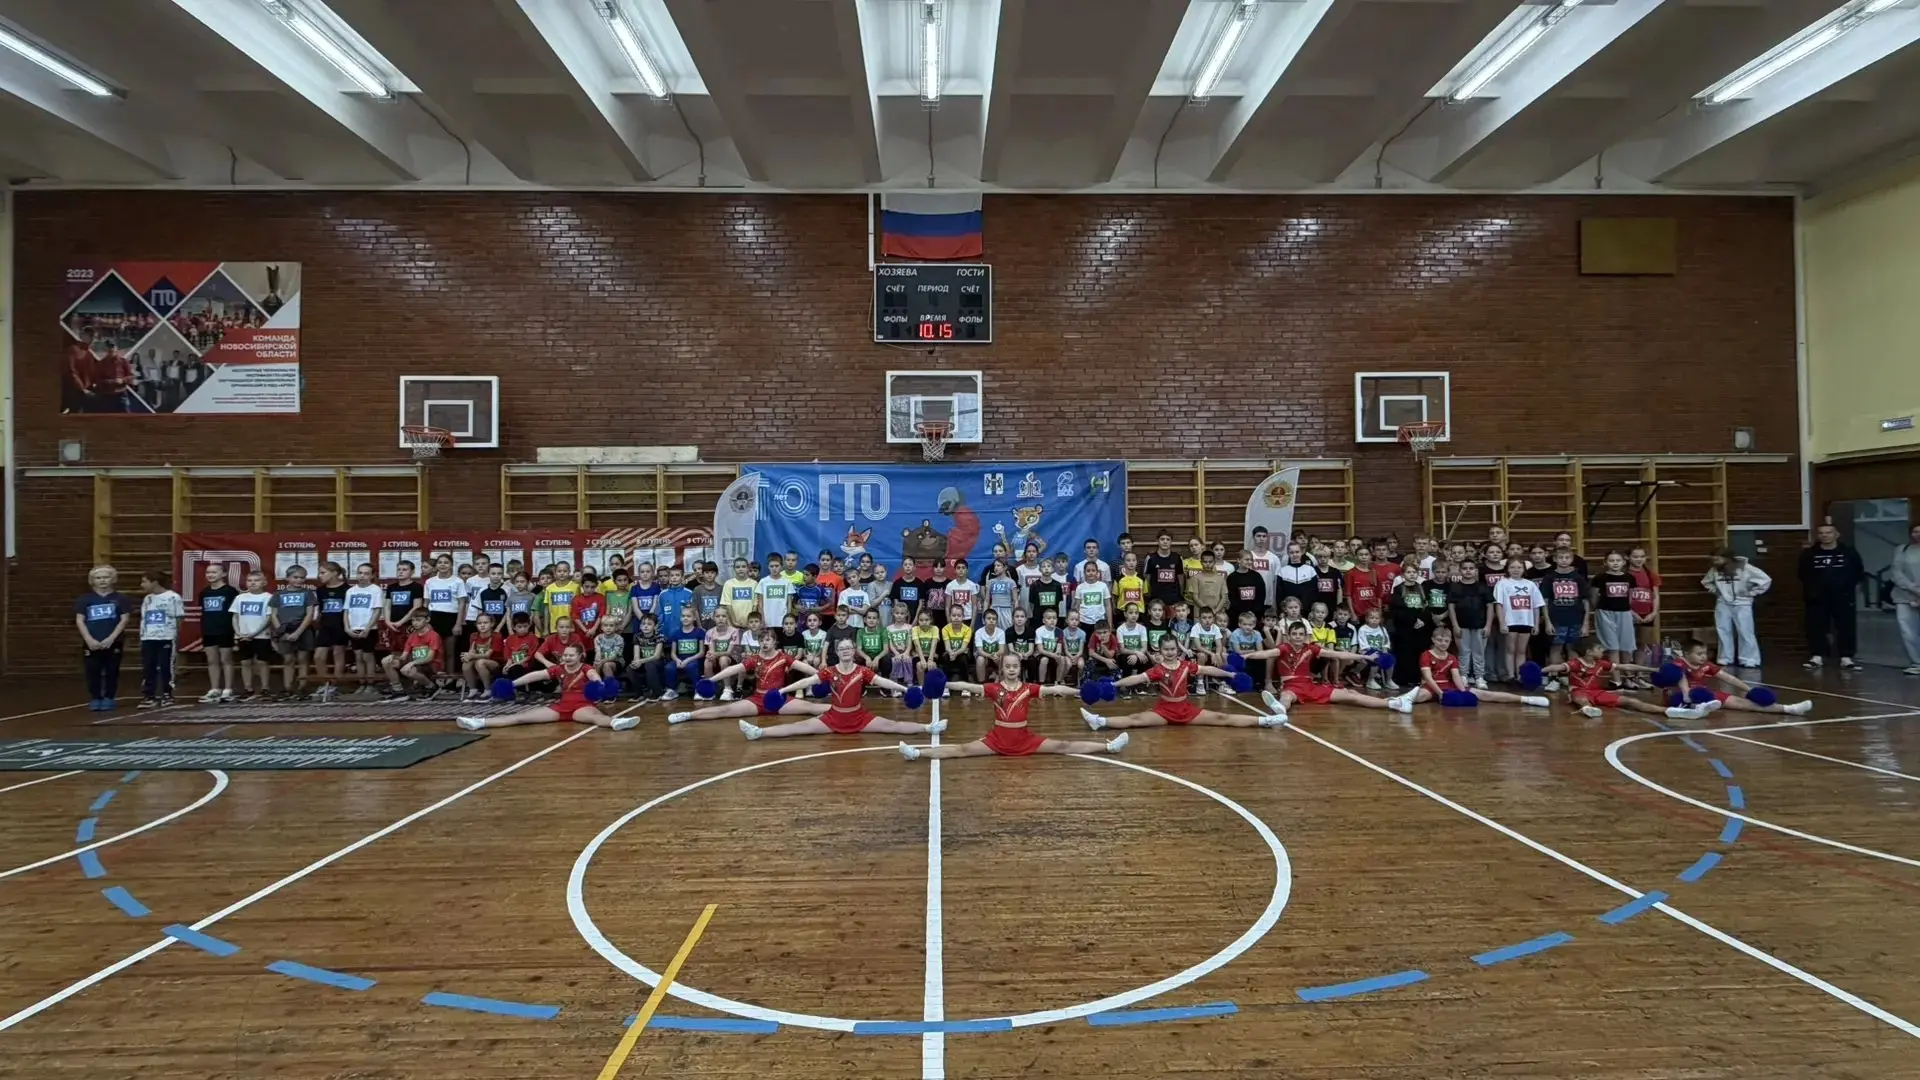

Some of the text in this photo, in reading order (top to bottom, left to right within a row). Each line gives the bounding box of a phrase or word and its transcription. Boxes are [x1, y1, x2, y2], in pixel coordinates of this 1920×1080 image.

[67, 269, 94, 278] 2023
[878, 268, 918, 276] ХОЗЯЕВА
[956, 268, 985, 276] ГОСТИ
[886, 284, 906, 293] СЧЁТ
[917, 284, 949, 293] ПЕРИОД
[961, 284, 980, 293] СЧЁТ
[151, 289, 176, 306] ГТО
[883, 315, 908, 324] ФОЛЫ
[920, 314, 947, 322] ВРЕМЯ
[958, 315, 984, 324] ФОЛЫ
[253, 335, 296, 343] КОМАНДА
[220, 343, 297, 351] НОВОСИБИРСКОЙ
[256, 351, 297, 359] ОБЛАСТИ
[284, 541, 316, 549] СТУПЕНЬ
[336, 541, 368, 549] СТУПЕНЬ
[438, 540, 470, 548] СТУПЕНЬ
[541, 539, 571, 547] СТУПЕНЬ
[1159, 571, 1174, 580] 028
[735, 590, 749, 598] 173
[1556, 585, 1574, 594] 022
[1608, 585, 1627, 594] 079
[283, 595, 301, 604] 122
[432, 592, 449, 600] 182
[351, 597, 368, 605] 179
[90, 606, 113, 617] 134
[241, 604, 260, 613] 140
[485, 603, 501, 612] 135
[864, 638, 879, 648] 211
